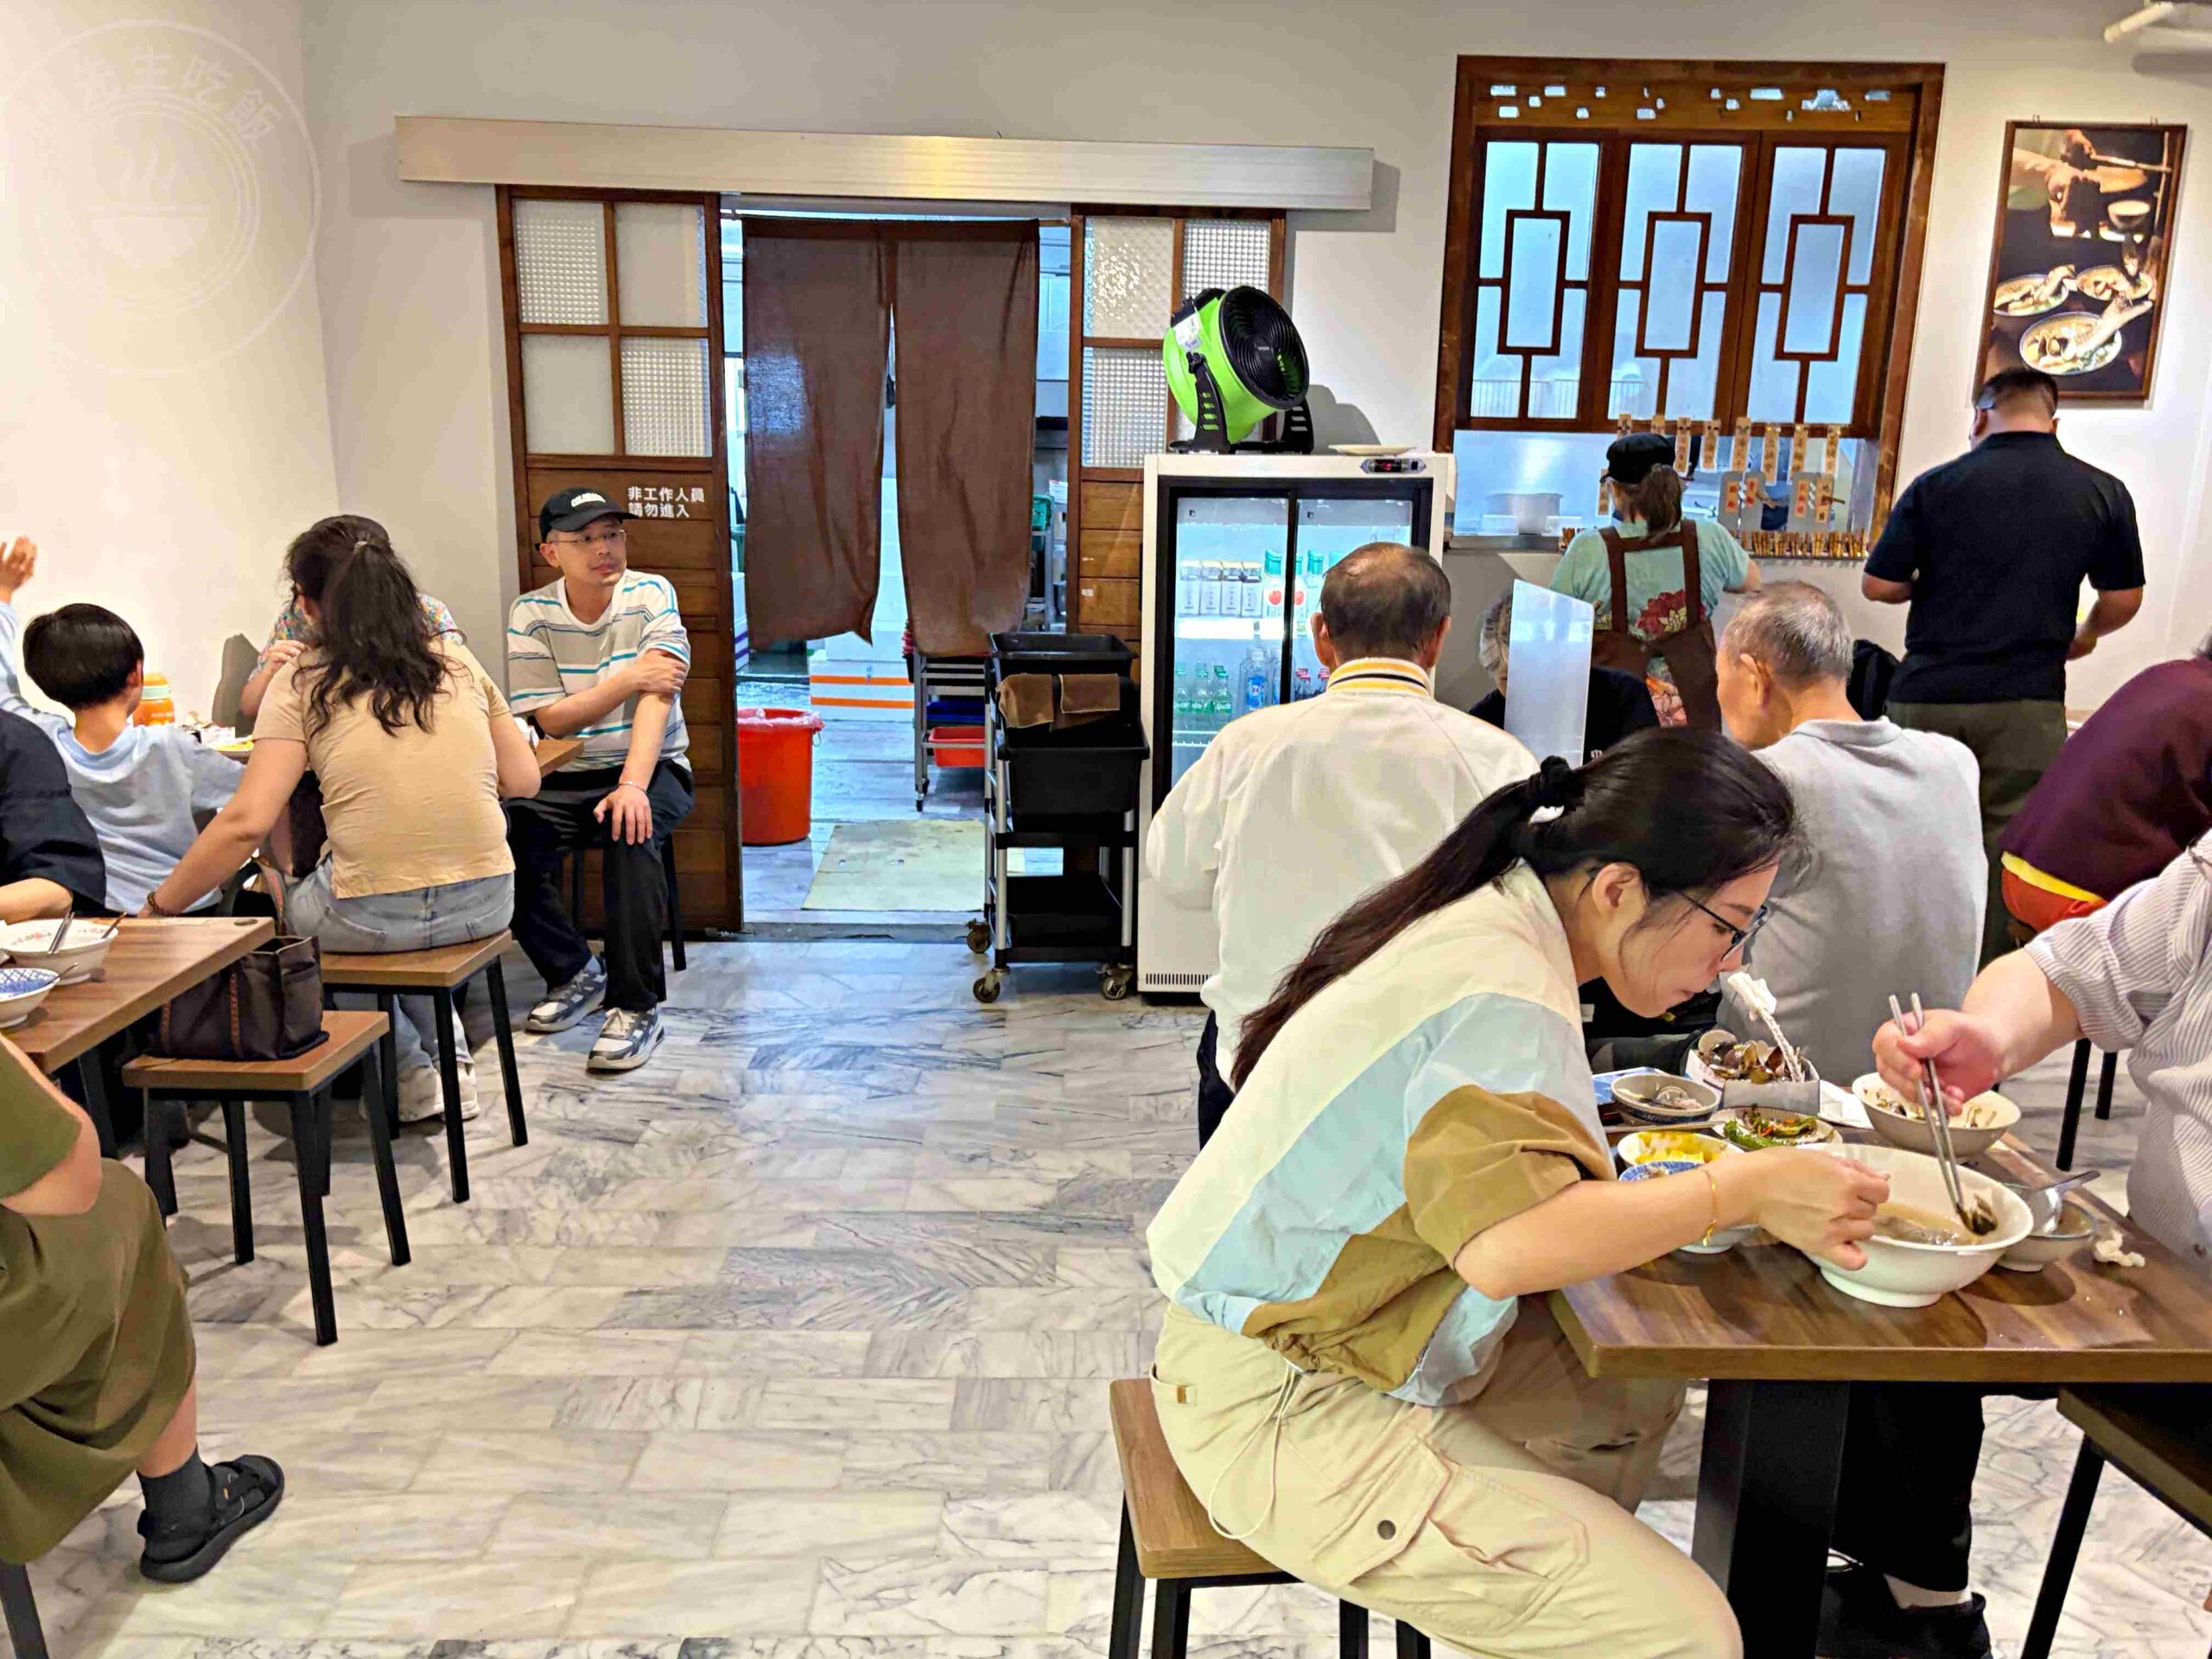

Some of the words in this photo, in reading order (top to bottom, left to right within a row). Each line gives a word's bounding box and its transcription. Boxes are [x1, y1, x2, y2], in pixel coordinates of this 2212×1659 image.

[627, 486, 705, 503] 非工作人員
[628, 502, 690, 518] 請勿進入
